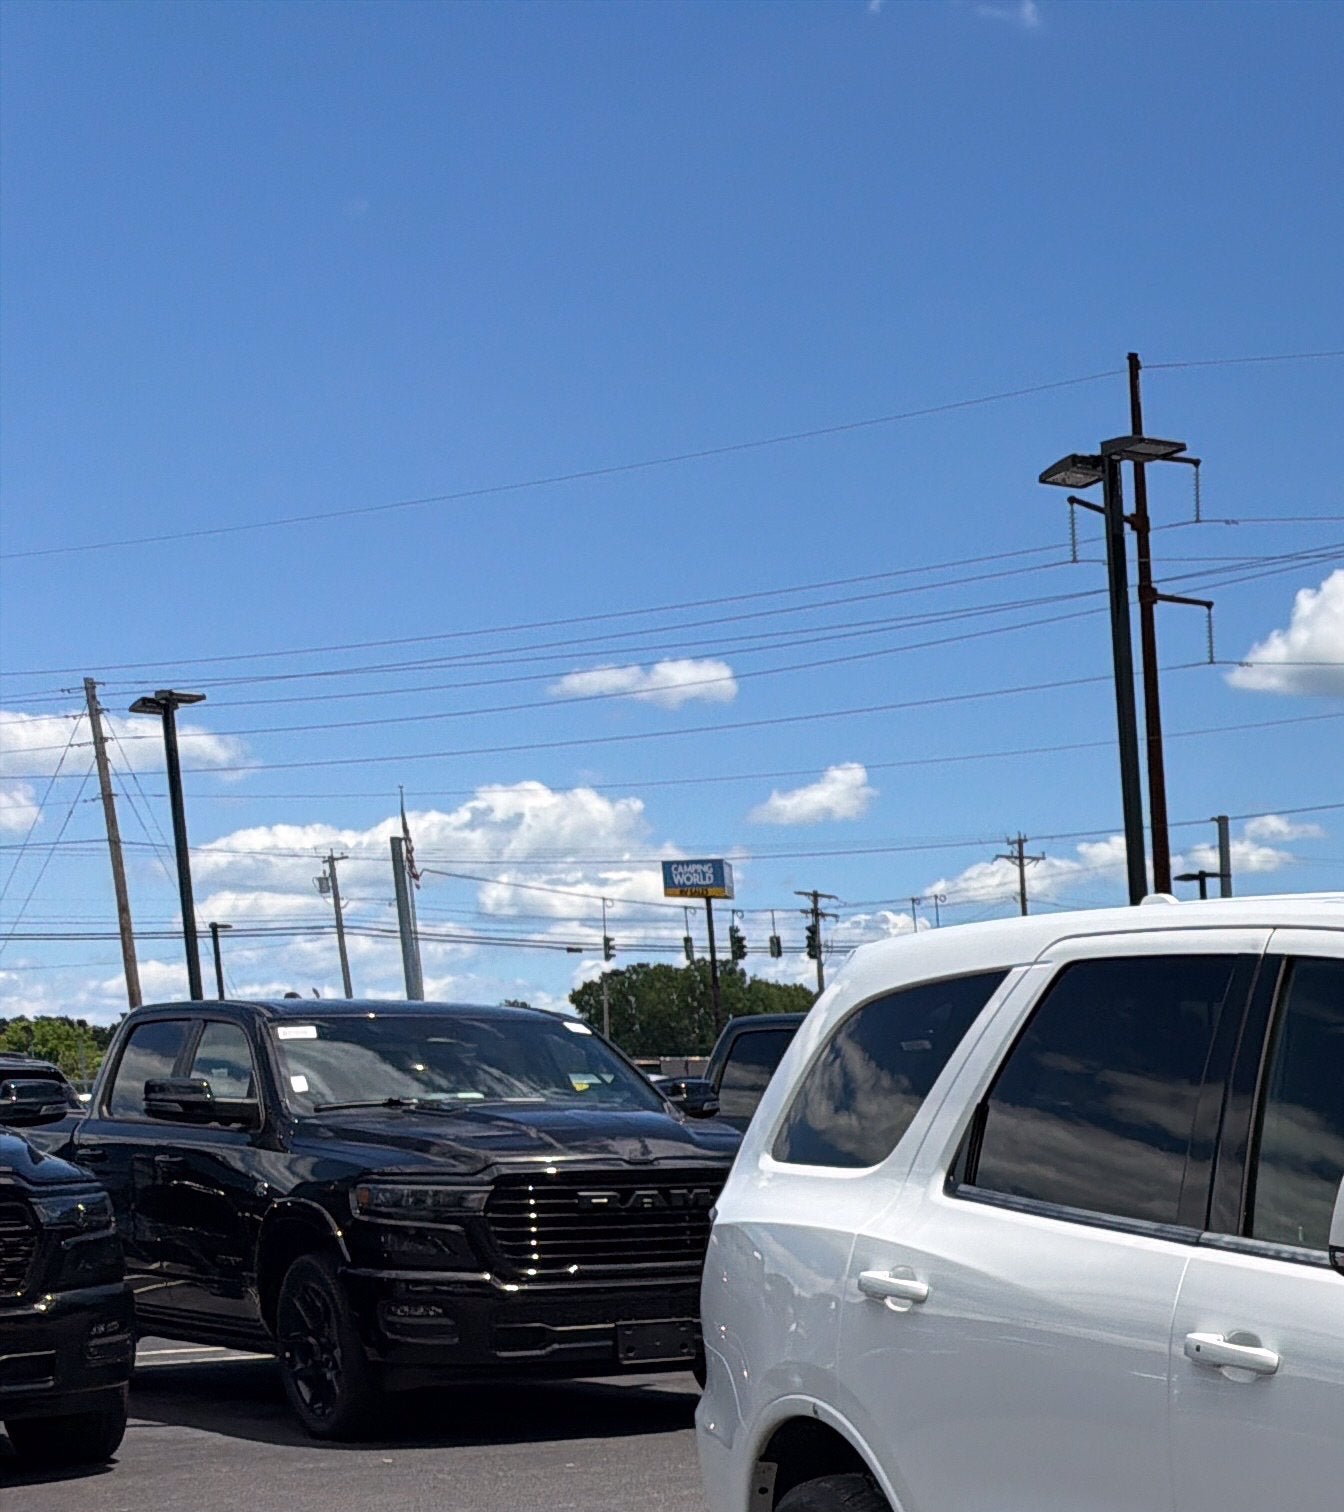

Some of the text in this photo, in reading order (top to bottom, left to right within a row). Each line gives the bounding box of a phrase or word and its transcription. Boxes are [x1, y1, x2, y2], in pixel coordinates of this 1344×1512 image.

[671, 863, 714, 875] CAMPING
[672, 873, 714, 885] WORLD
[576, 1188, 714, 1211] RAM
